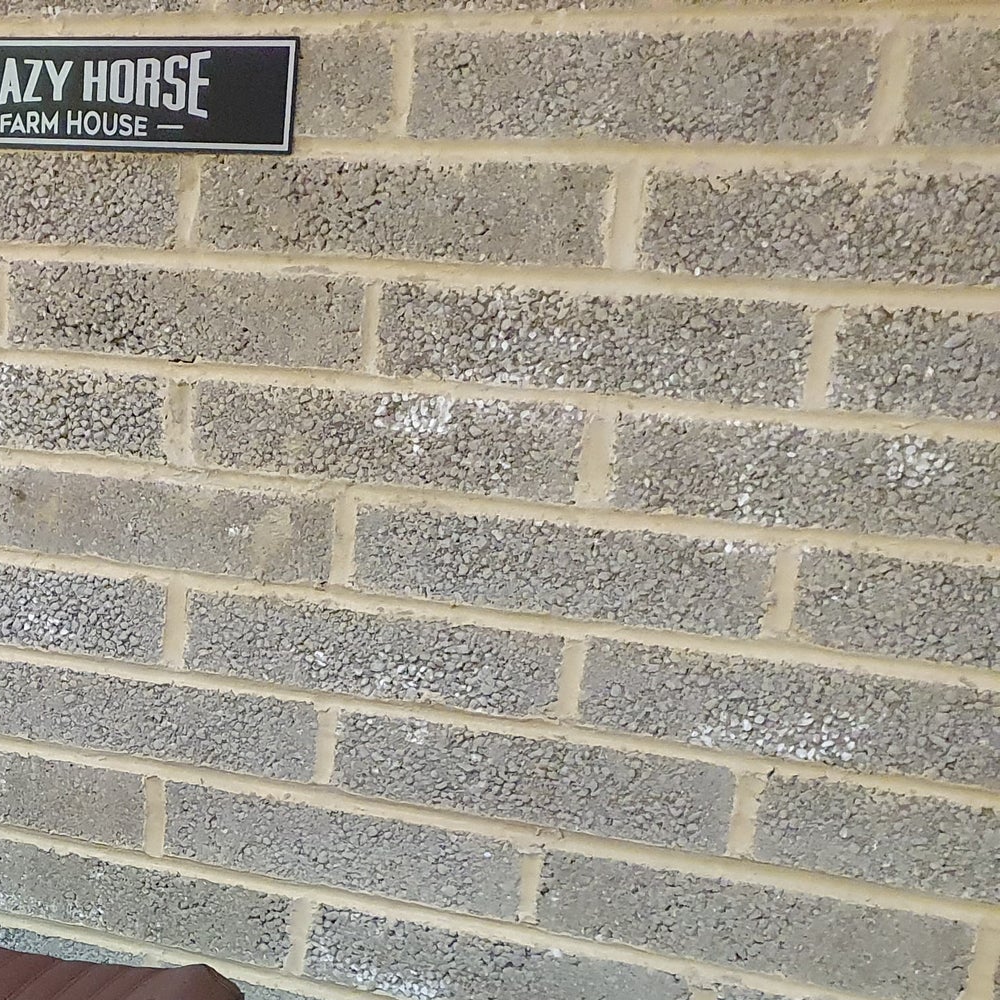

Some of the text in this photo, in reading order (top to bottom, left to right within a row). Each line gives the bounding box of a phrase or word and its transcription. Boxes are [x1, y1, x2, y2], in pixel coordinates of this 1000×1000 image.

[83, 50, 211, 119] HORSE
[0, 110, 148, 136] FARM HOUSE
